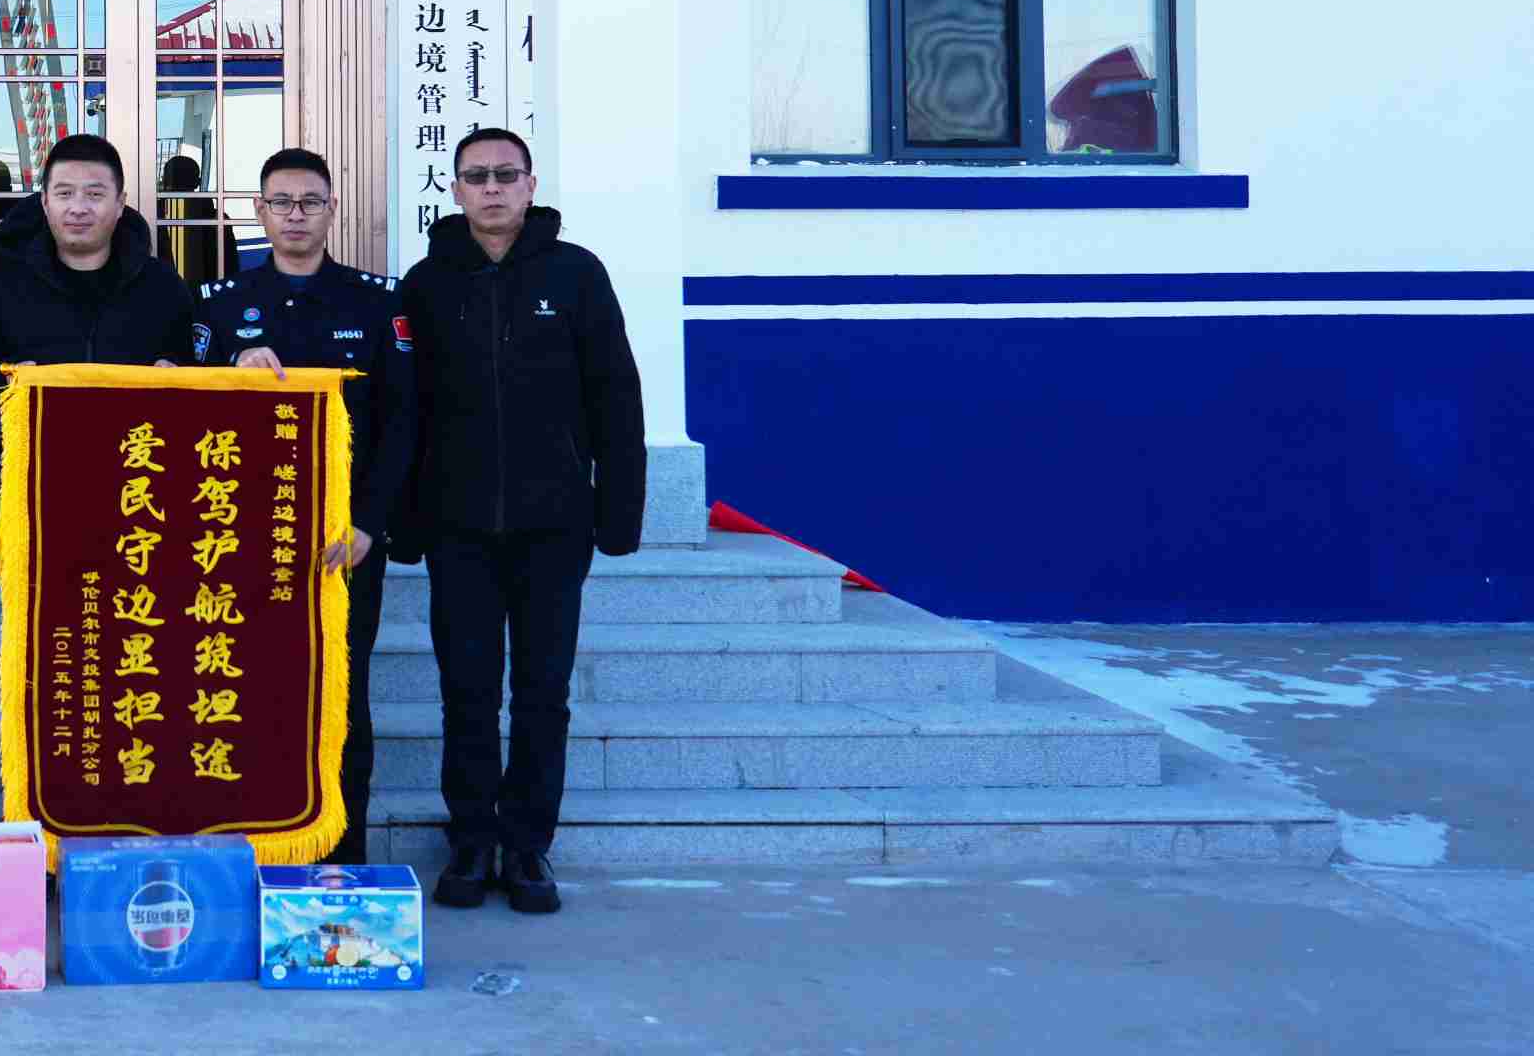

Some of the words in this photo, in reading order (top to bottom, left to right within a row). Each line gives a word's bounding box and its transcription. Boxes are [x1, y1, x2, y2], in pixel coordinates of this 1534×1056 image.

[112, 422, 166, 785] 爱民守边显担当
[184, 430, 245, 781] 保驾护航筑坦途
